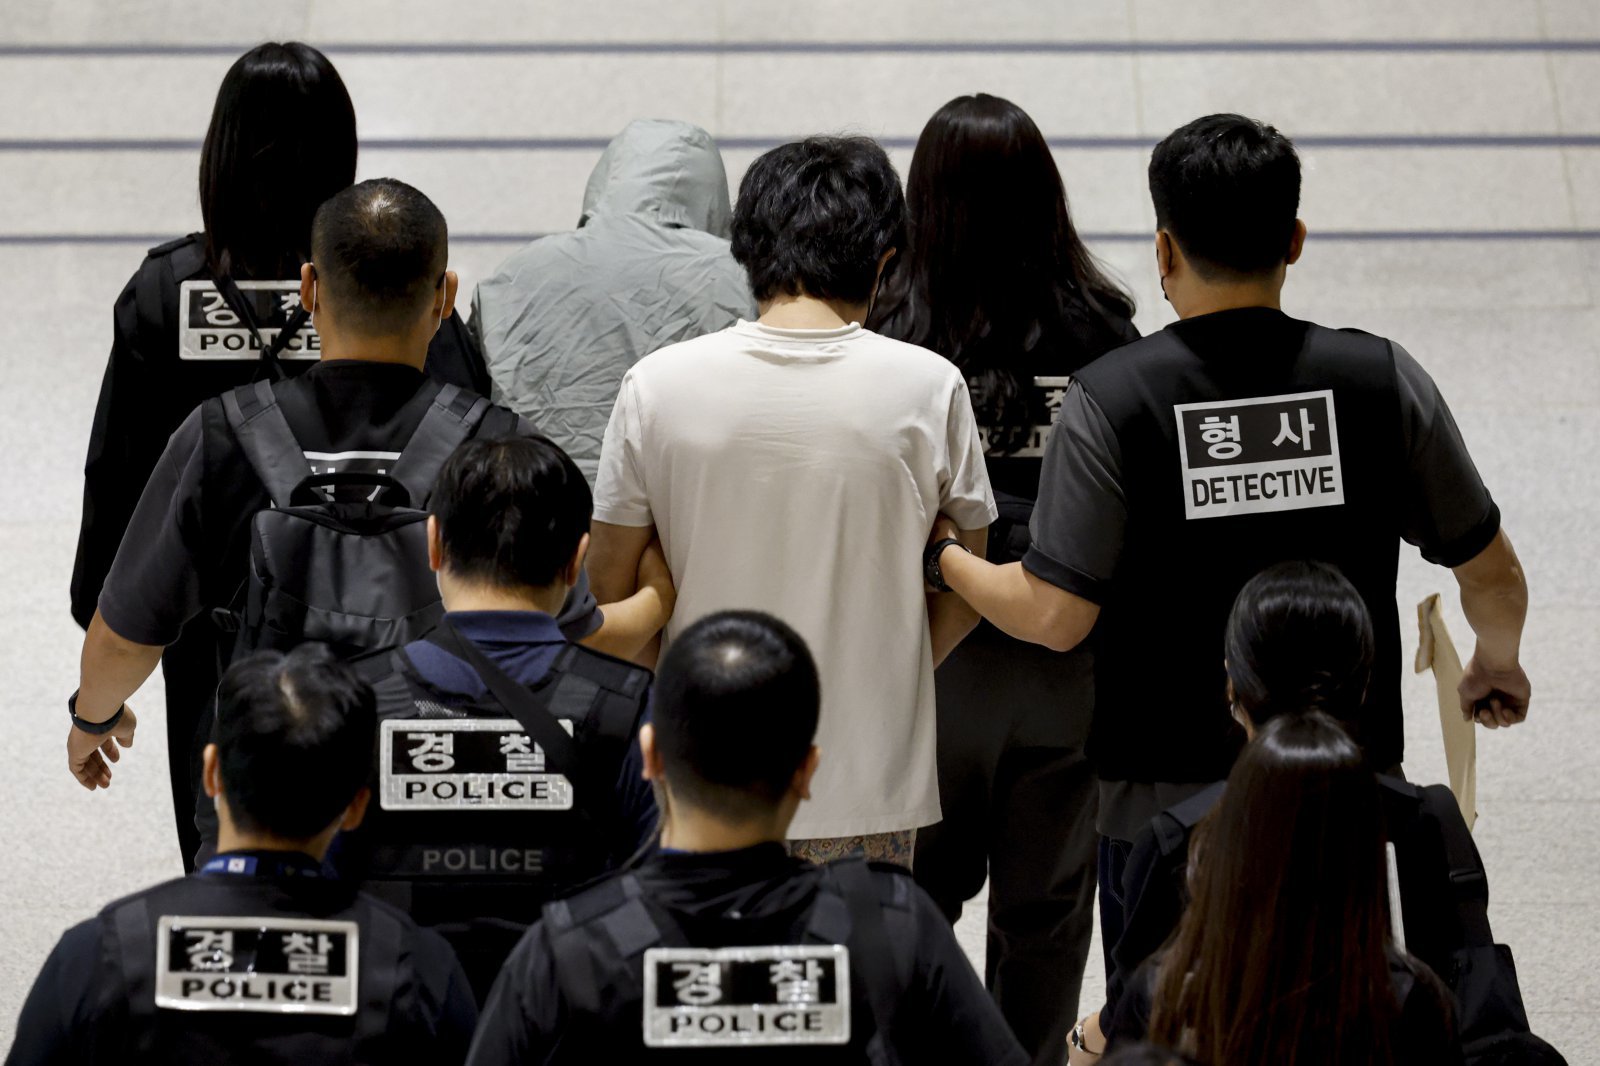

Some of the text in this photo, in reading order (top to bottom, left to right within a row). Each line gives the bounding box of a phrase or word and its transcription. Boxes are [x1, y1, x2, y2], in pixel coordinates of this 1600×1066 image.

[1191, 466, 1336, 507] DETECTIVE
[405, 781, 549, 800] POLICE
[422, 849, 543, 872] POLICE
[181, 979, 331, 1002] POLICE
[670, 1011, 824, 1034] POLICE
